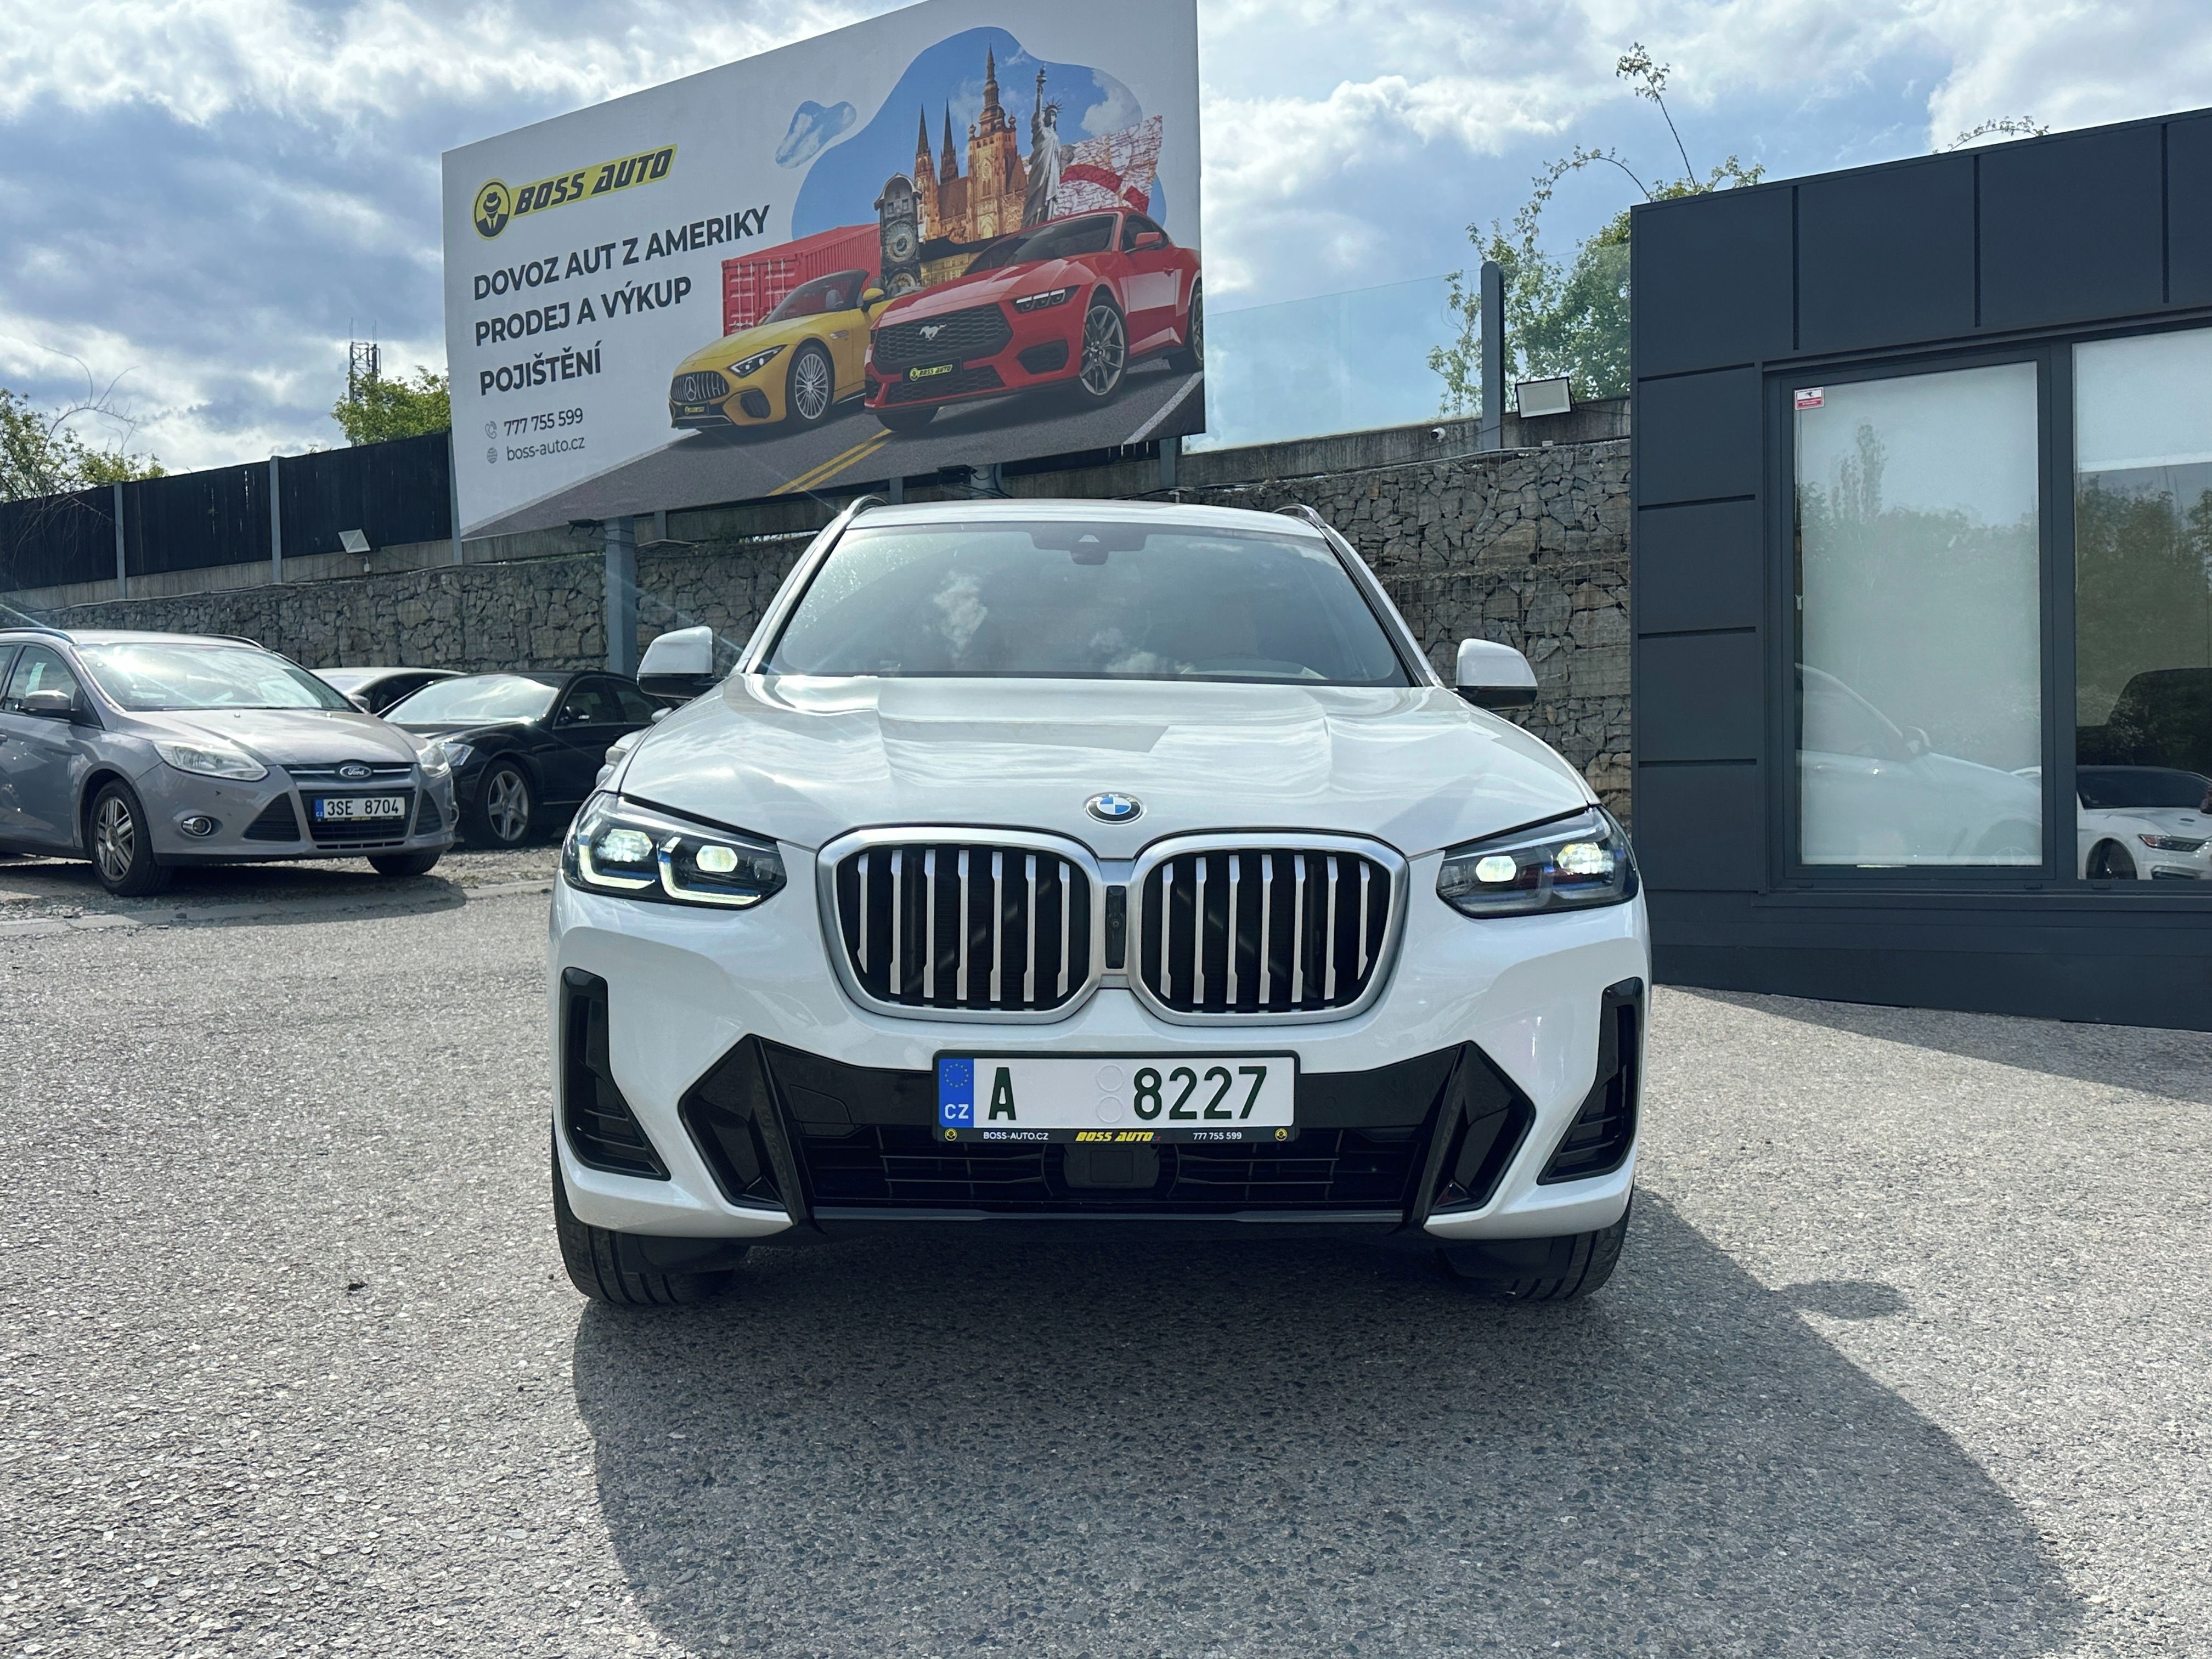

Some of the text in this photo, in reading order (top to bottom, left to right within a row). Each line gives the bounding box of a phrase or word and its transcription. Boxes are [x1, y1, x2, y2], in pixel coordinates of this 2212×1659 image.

[514, 149, 673, 216] BOSS AUTO
[474, 205, 770, 300] DOVOZ AUT Z AMERIKY
[475, 276, 691, 346] PRODEJ A VÝKUP
[479, 340, 602, 396] POJIŠTĚNÍ
[504, 408, 583, 436] 777 755 599
[506, 437, 585, 461] boss-auto.cz
[327, 799, 399, 816] 3SE 8704
[988, 1066, 1267, 1120] A 8227
[944, 1104, 969, 1119] CZ
[983, 1132, 1048, 1140] BOSS-AUTO.CZ
[1074, 1132, 1113, 1142] BOSS
[1114, 1132, 1155, 1142] AUTO
[1192, 1131, 1243, 1140] 777 755 599
